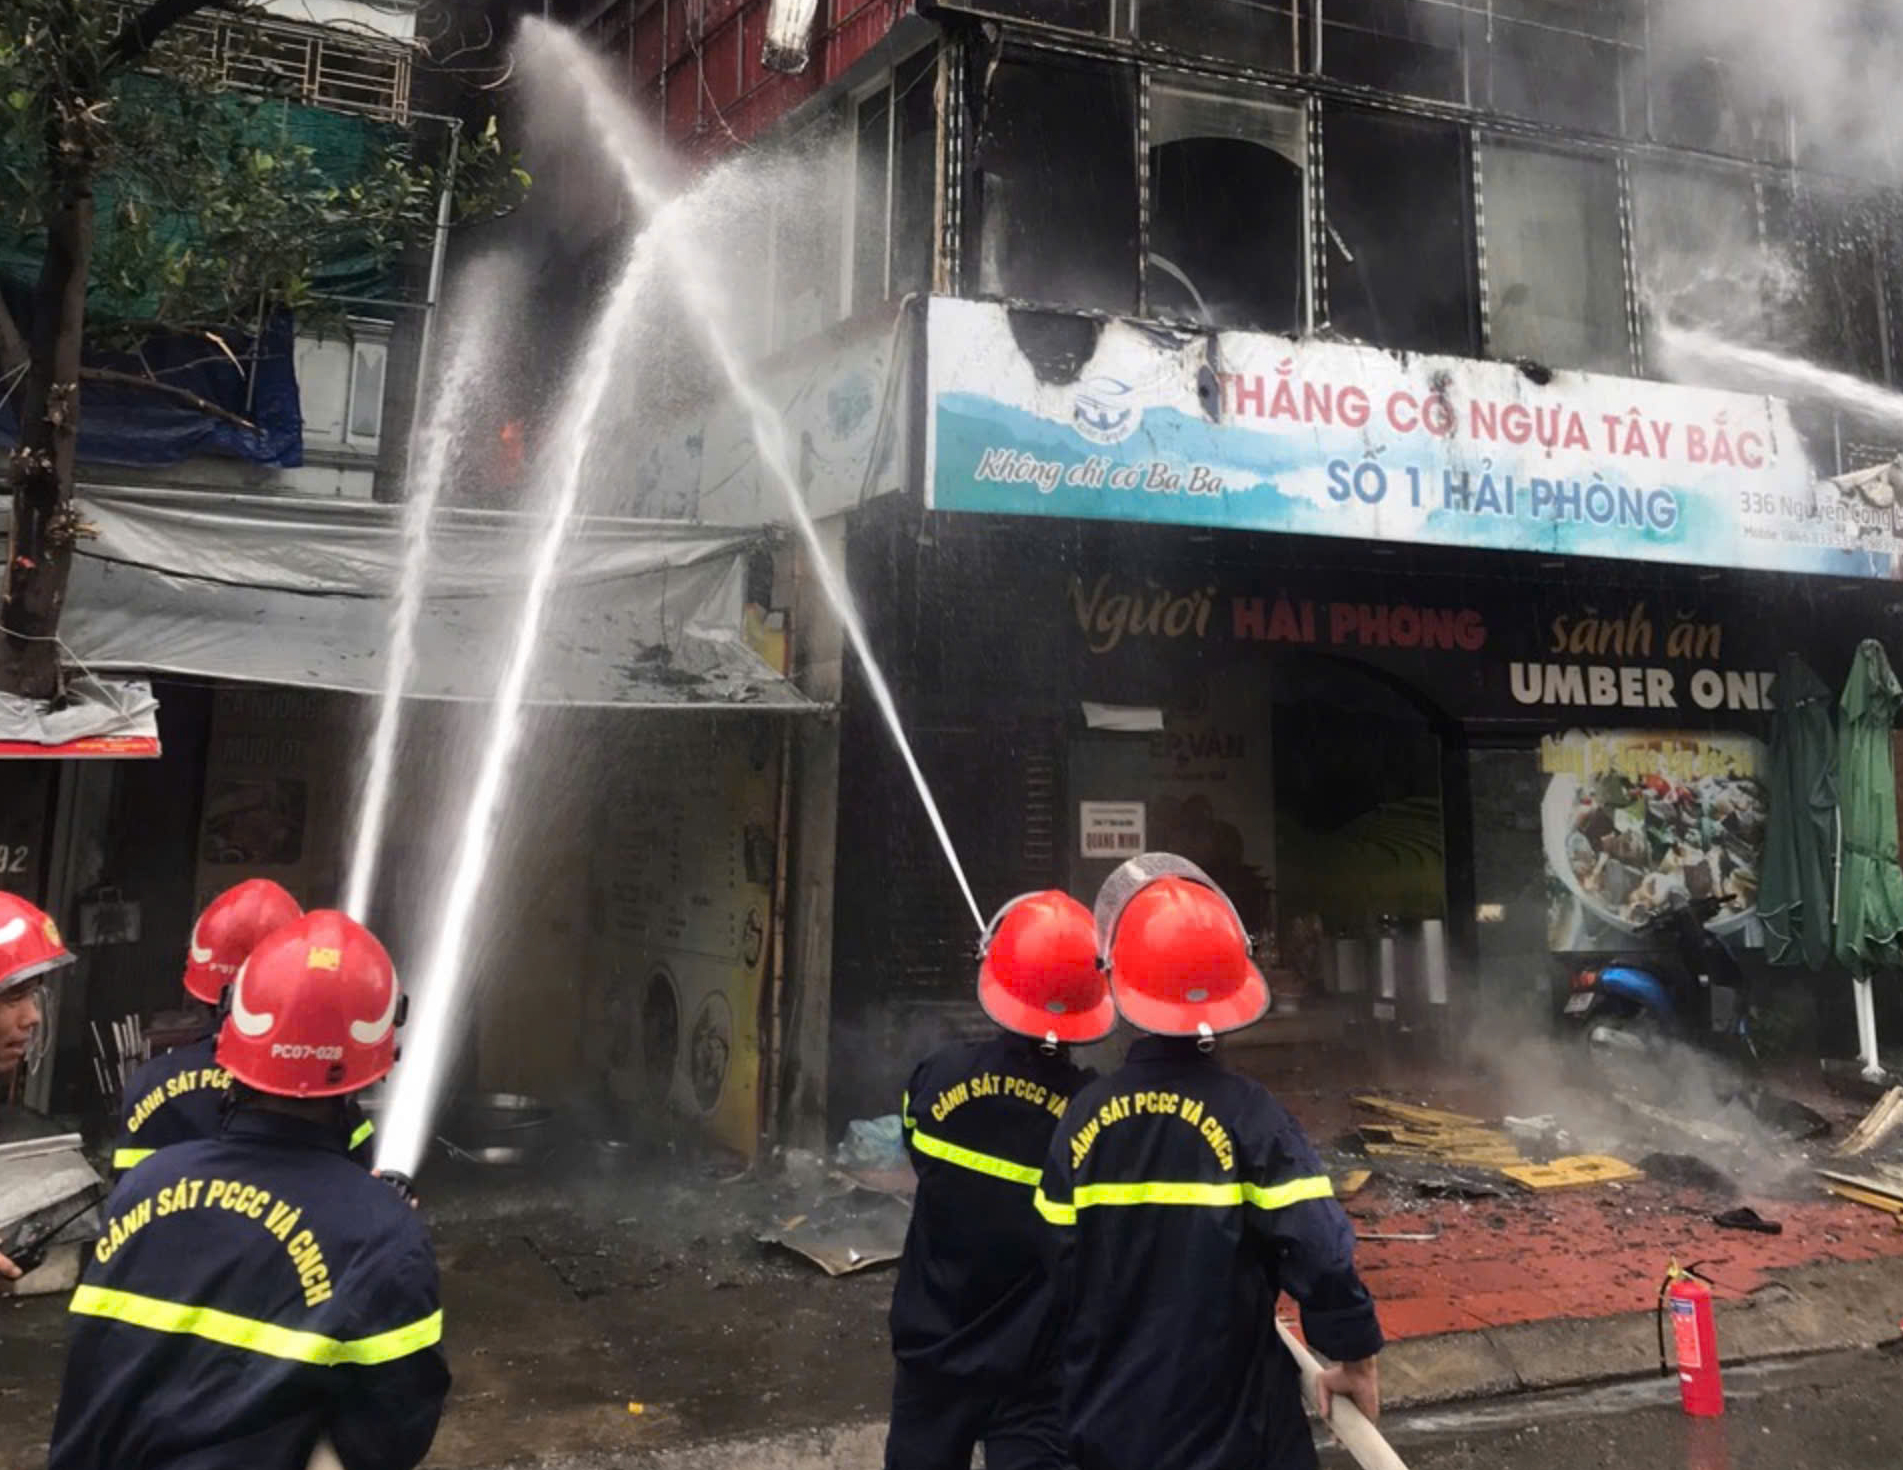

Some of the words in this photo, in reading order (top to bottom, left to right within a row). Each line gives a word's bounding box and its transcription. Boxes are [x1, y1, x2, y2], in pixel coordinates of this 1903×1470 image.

[1470, 399, 1590, 459] NGỰA
[1602, 406, 1672, 460] TÂY
[1686, 410, 1764, 470] BẮC
[976, 449, 1062, 492] Không
[1111, 464, 1144, 488] có
[1146, 463, 1181, 490] Ba
[1188, 465, 1223, 493] Ba
[1327, 444, 1388, 504] SỐ
[1405, 466, 1421, 508] 1
[1443, 457, 1514, 516] HẢI
[1530, 471, 1678, 530] PHÒNG
[1740, 491, 1776, 515] 336
[1551, 603, 1653, 657] sành
[1667, 608, 1722, 660] ăn
[1509, 662, 1678, 708] UMBER
[166, 1070, 198, 1098] SÁT
[200, 1067, 233, 1090] PCC
[970, 1071, 1001, 1098] SÁT
[1004, 1075, 1047, 1106] PCCC
[1099, 1096, 1131, 1127] SÁT
[1134, 1090, 1180, 1115] PCCC
[1179, 1096, 1204, 1127] VÀ
[95, 1197, 153, 1265] CẢNH
[155, 1176, 204, 1218] SÁT
[203, 1178, 272, 1220] PCCC
[263, 1199, 303, 1242] VÀ
[287, 1228, 334, 1309] CNCH
